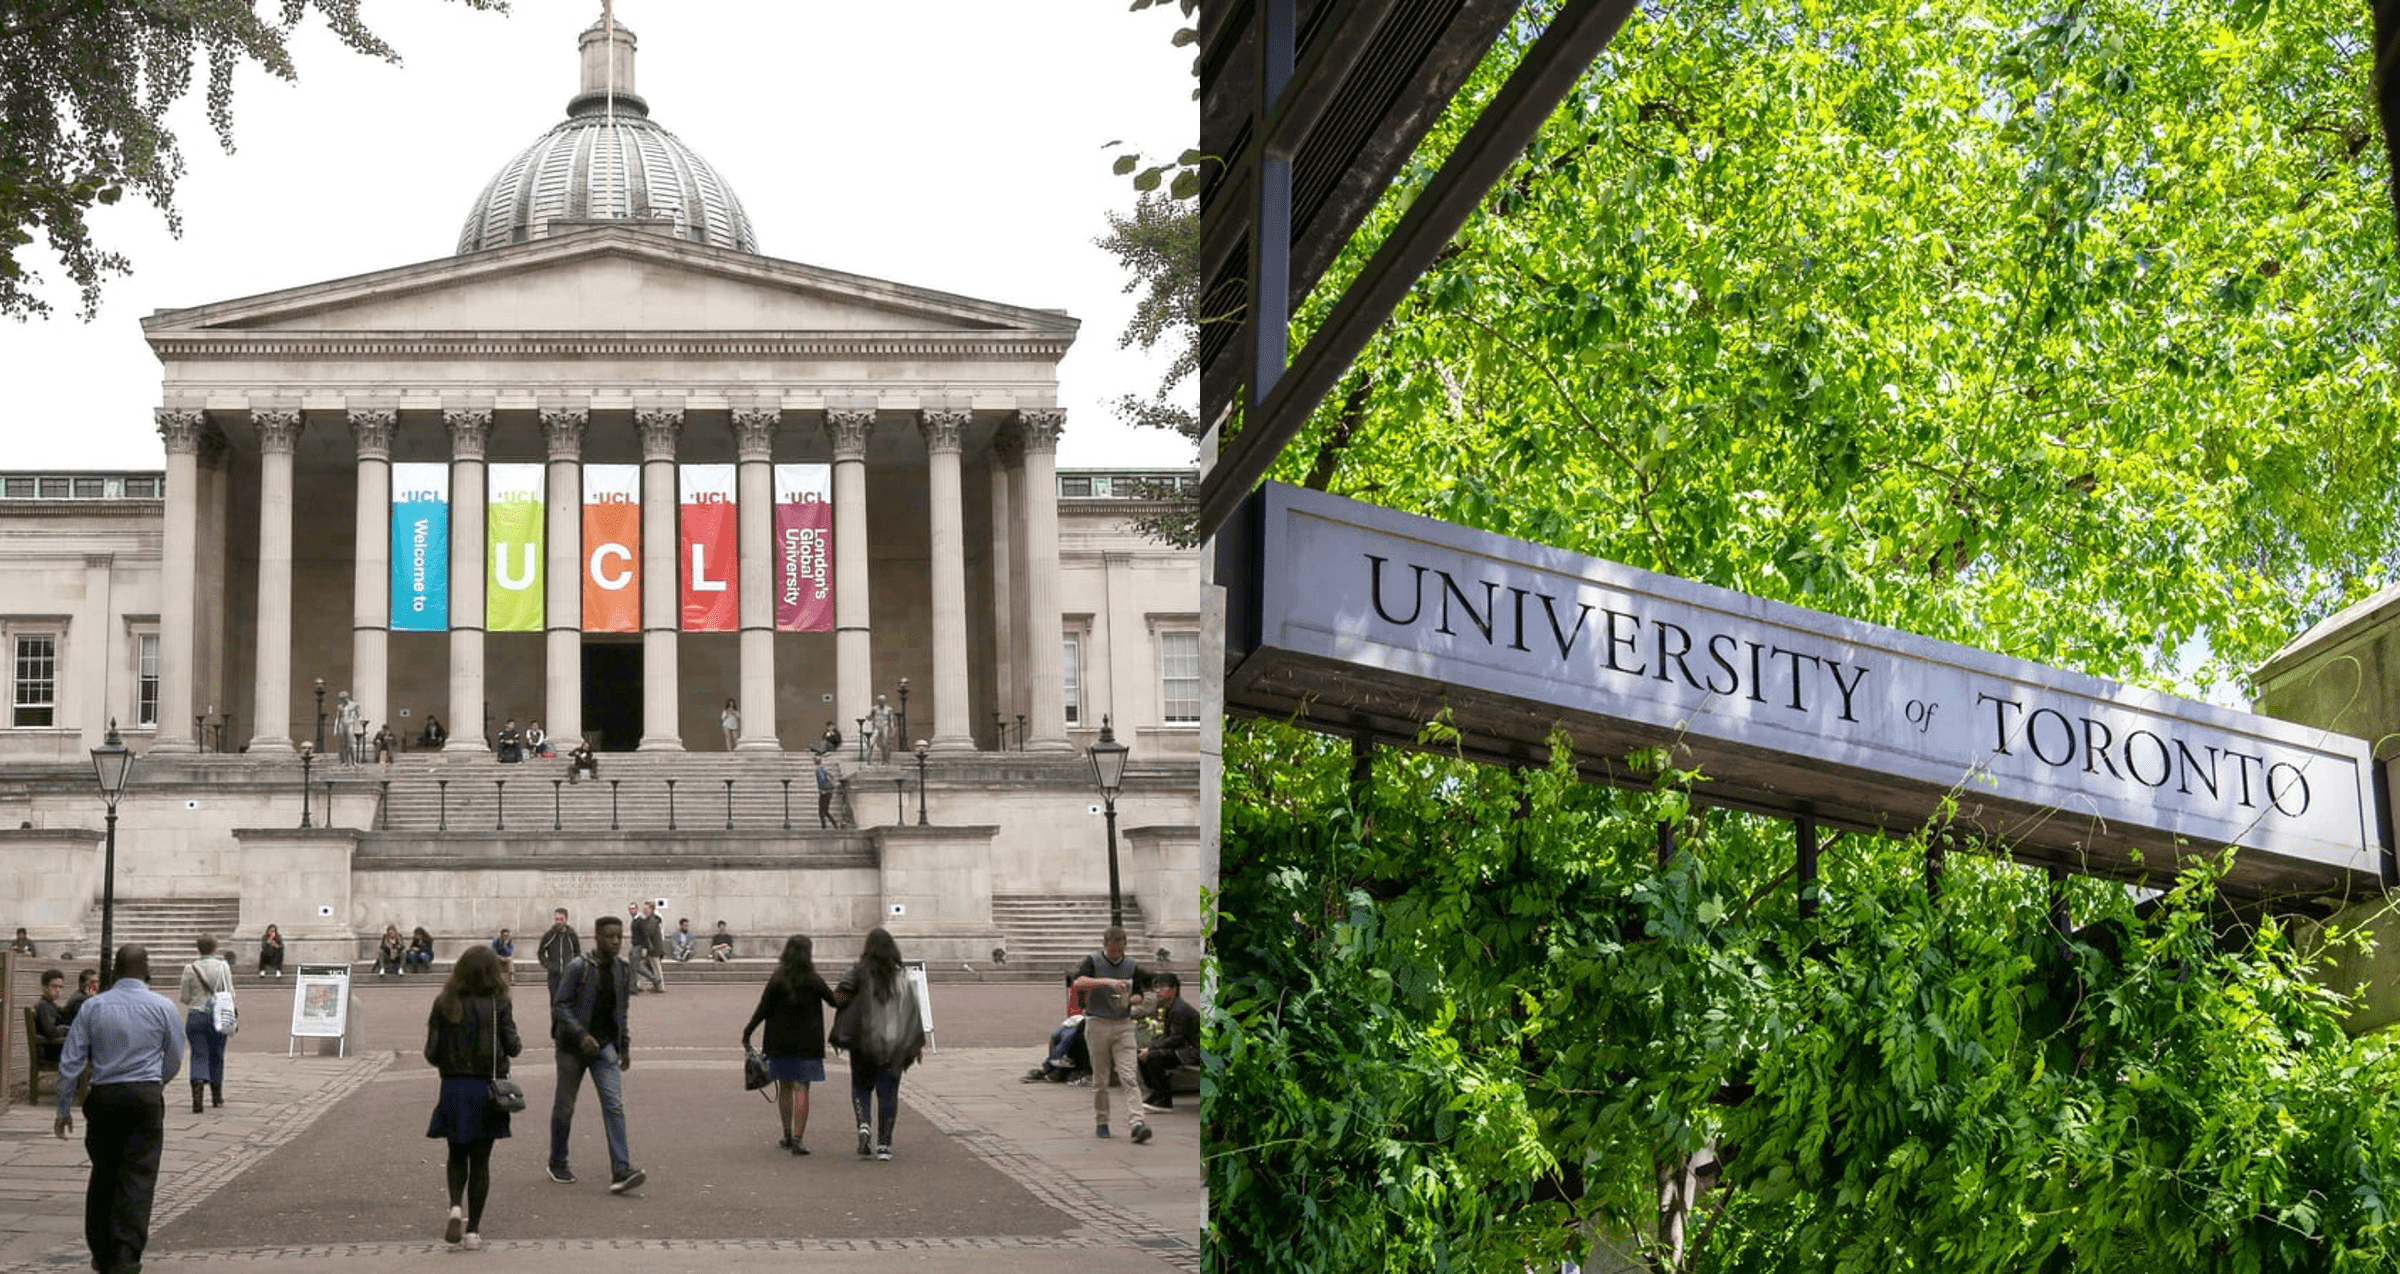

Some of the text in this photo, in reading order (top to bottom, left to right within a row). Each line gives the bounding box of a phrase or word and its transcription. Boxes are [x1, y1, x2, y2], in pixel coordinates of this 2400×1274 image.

[413, 519, 428, 612] Welcome to
[495, 542, 536, 590] U
[590, 542, 634, 590] C
[692, 543, 727, 591] L
[784, 529, 800, 605] University
[800, 528, 814, 579] Global
[814, 529, 829, 600] London's
[1363, 553, 1869, 723] UNIVERSITY
[1976, 692, 2309, 817] TORONTO
